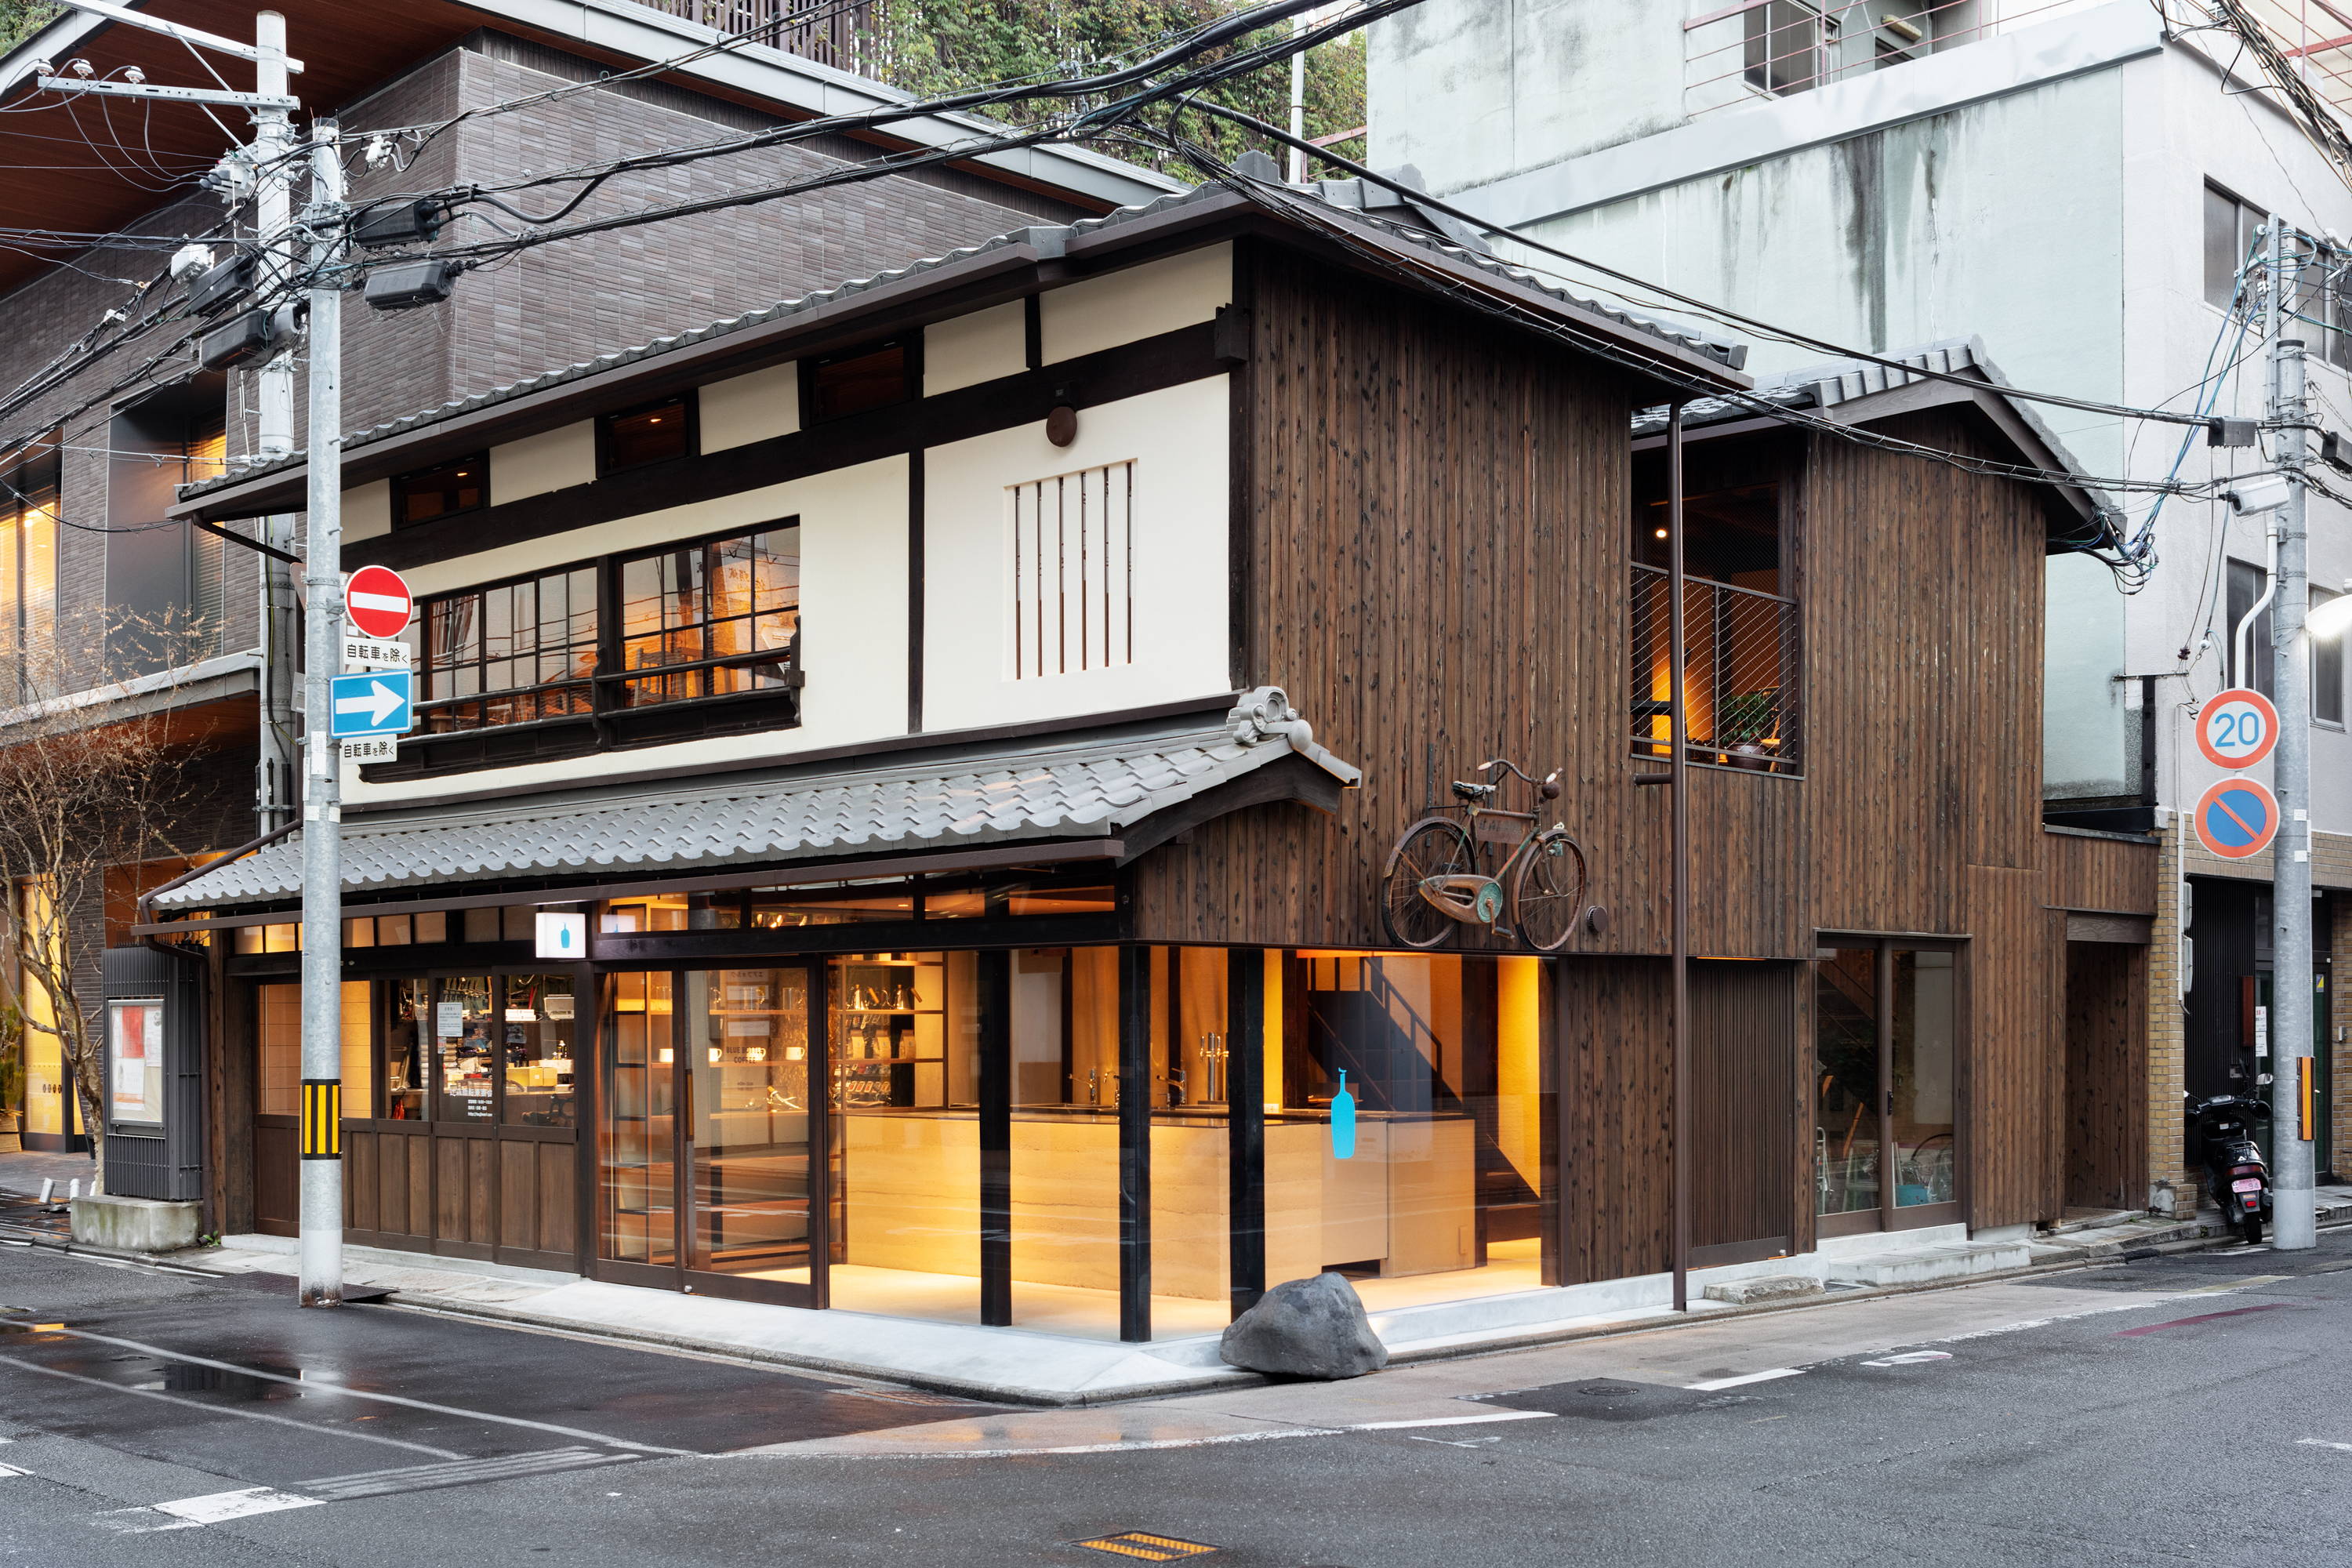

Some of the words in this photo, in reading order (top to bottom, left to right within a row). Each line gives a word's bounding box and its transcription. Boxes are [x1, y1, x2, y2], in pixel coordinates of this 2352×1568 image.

[347, 643, 408, 663] 自転車を除く
[2215, 712, 2259, 747] 20
[344, 741, 394, 758] 自転車を除く
